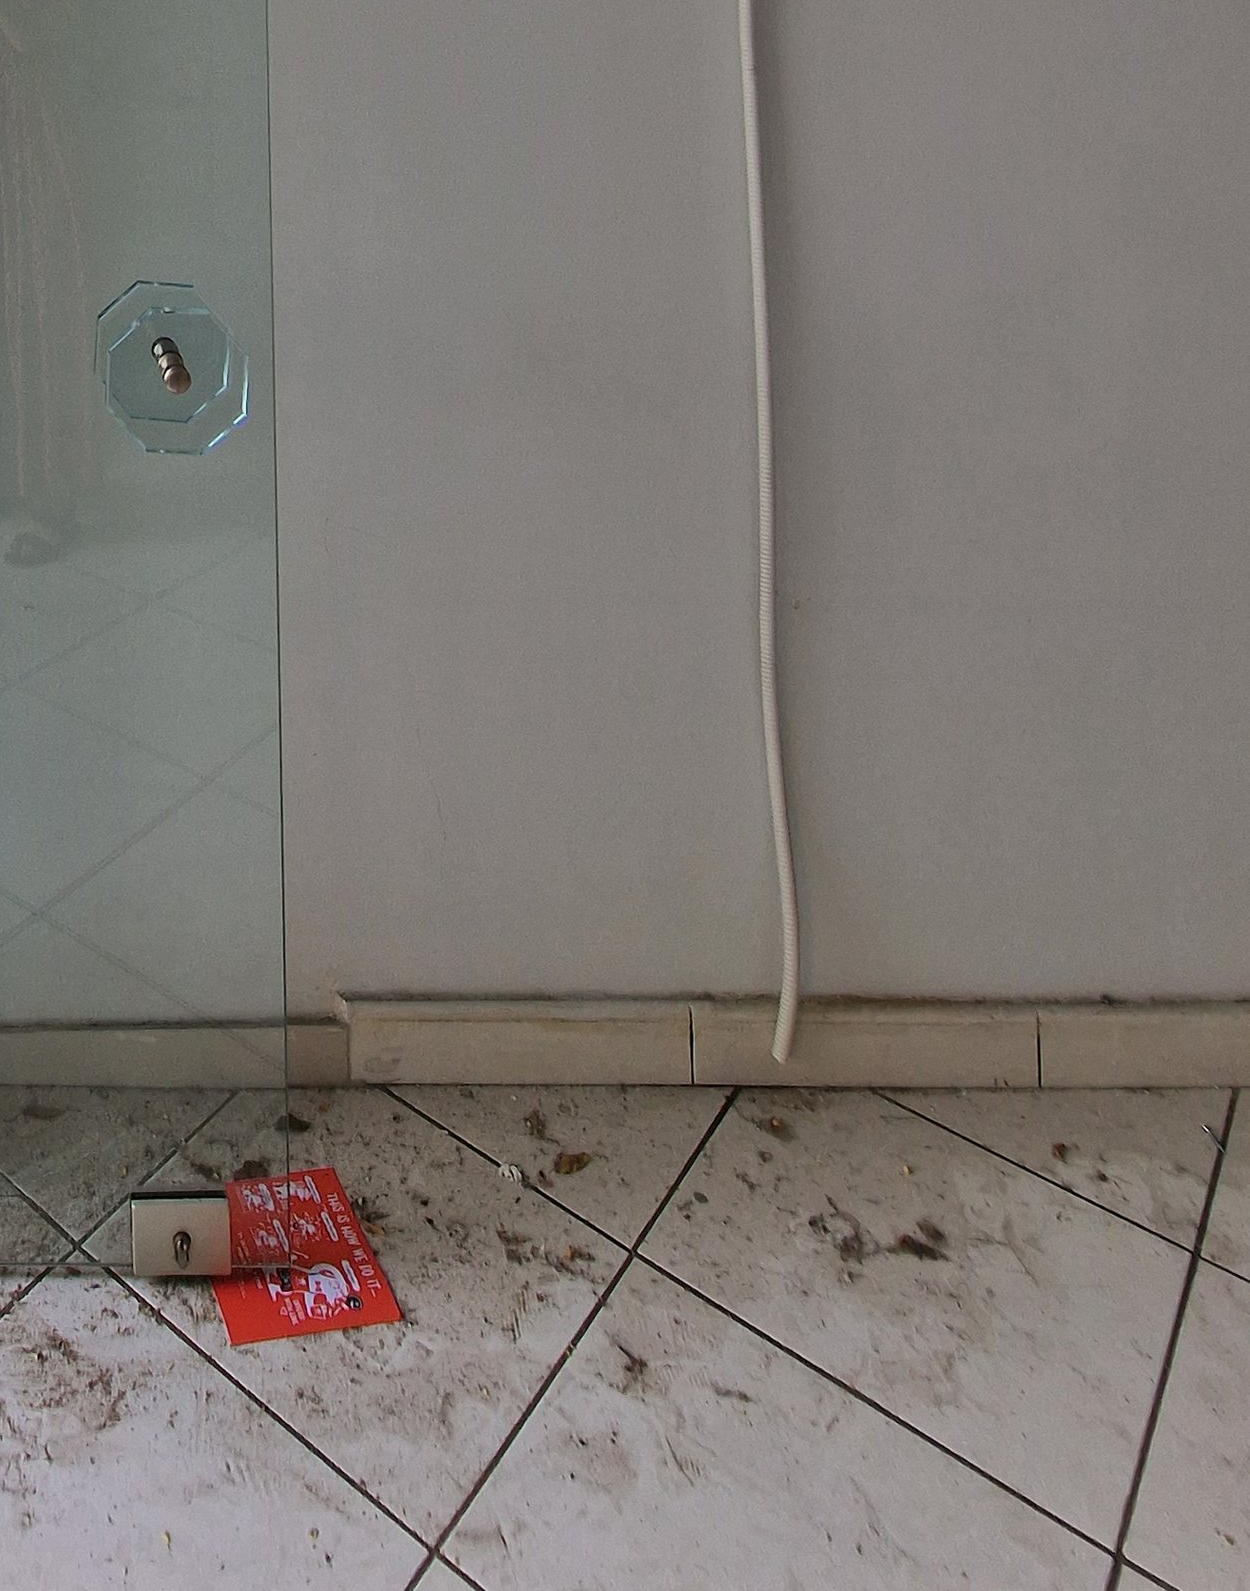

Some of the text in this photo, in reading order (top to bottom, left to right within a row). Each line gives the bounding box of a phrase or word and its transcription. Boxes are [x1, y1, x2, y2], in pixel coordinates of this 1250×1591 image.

[326, 1192, 344, 1212] THIS
[337, 1212, 349, 1224] IS
[340, 1225, 361, 1246] HOW
[353, 1248, 368, 1263] WE
[358, 1264, 374, 1276] DO
